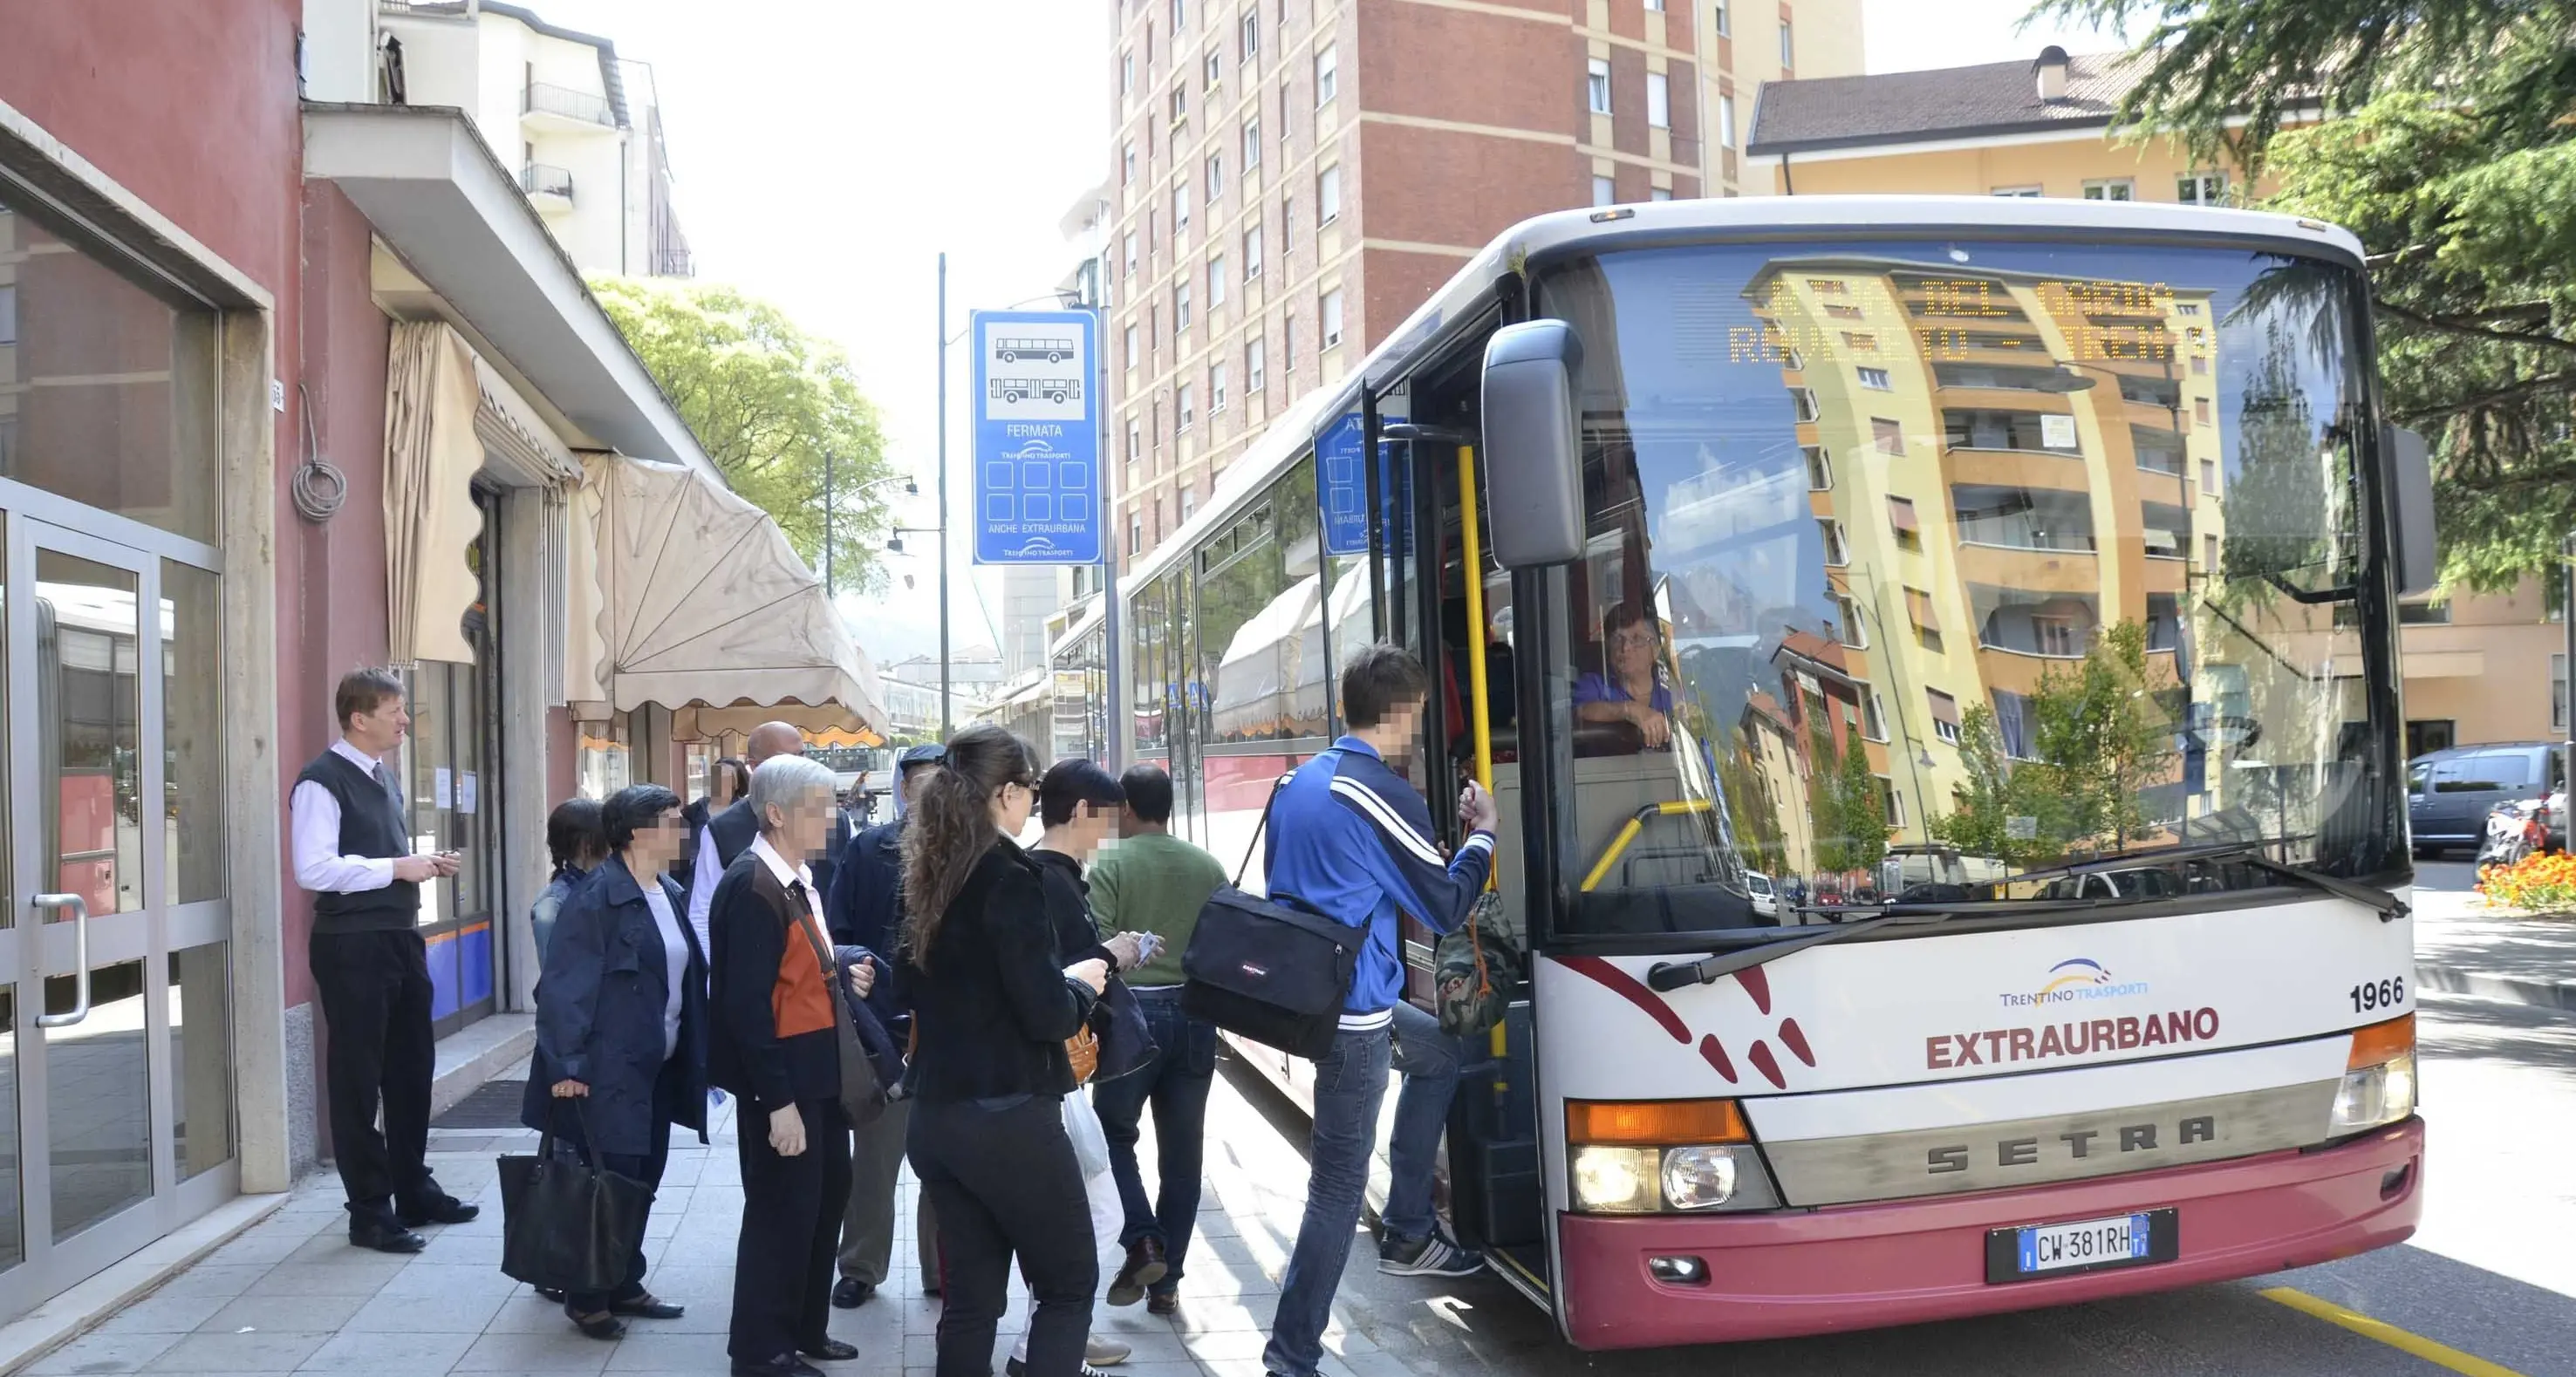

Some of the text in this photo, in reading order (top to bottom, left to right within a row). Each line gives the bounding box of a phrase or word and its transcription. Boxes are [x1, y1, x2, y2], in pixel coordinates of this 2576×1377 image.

[1922, 281, 2007, 316] DEL
[2037, 281, 2175, 316] GARDA
[1729, 326, 1968, 362] ROVERETO
[2059, 325, 2217, 359] TRENTO
[1007, 425, 1063, 437] FERMATA
[988, 524, 1086, 534] ANCHE EXTRAURBANA
[1999, 982, 2149, 1006] TRENTINO TRASPORTI
[2350, 976, 2404, 1013] 1966
[1927, 1007, 2220, 1069] EXTRAURBANO
[1928, 1116, 2214, 1174] SETRA
